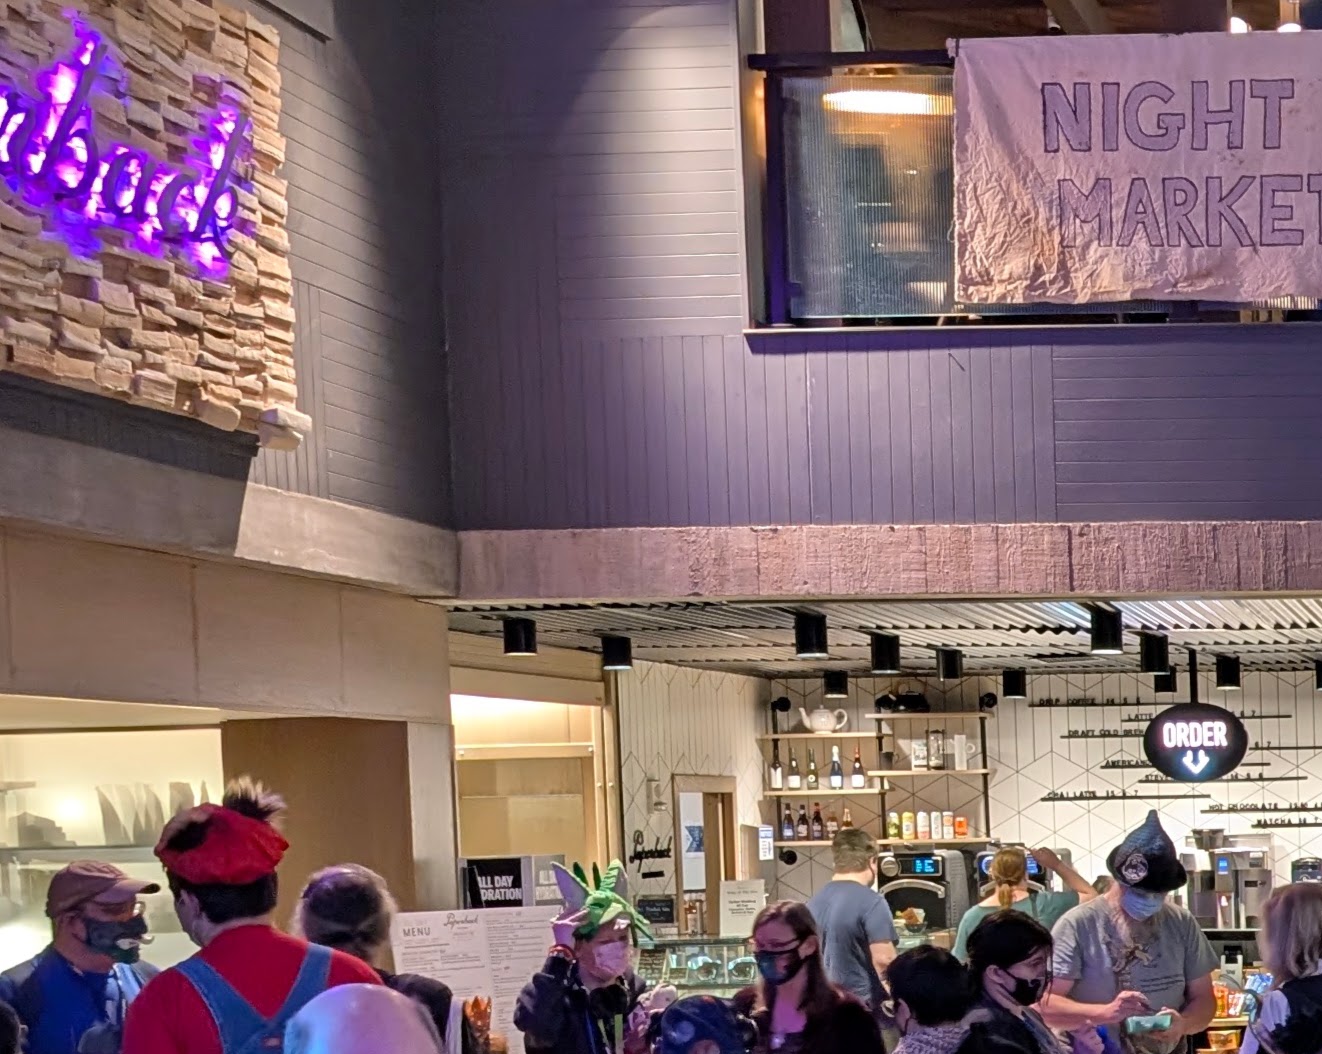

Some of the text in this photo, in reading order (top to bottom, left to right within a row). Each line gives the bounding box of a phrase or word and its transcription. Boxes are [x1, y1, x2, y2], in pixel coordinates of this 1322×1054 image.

[1041, 79, 1295, 153] NIGHT
[1163, 721, 1228, 748] ORDER
[1209, 803, 1223, 811] HOT
[494, 875, 514, 888] DAY
[480, 888, 522, 901] DRATION
[402, 927, 431, 937] MENU
